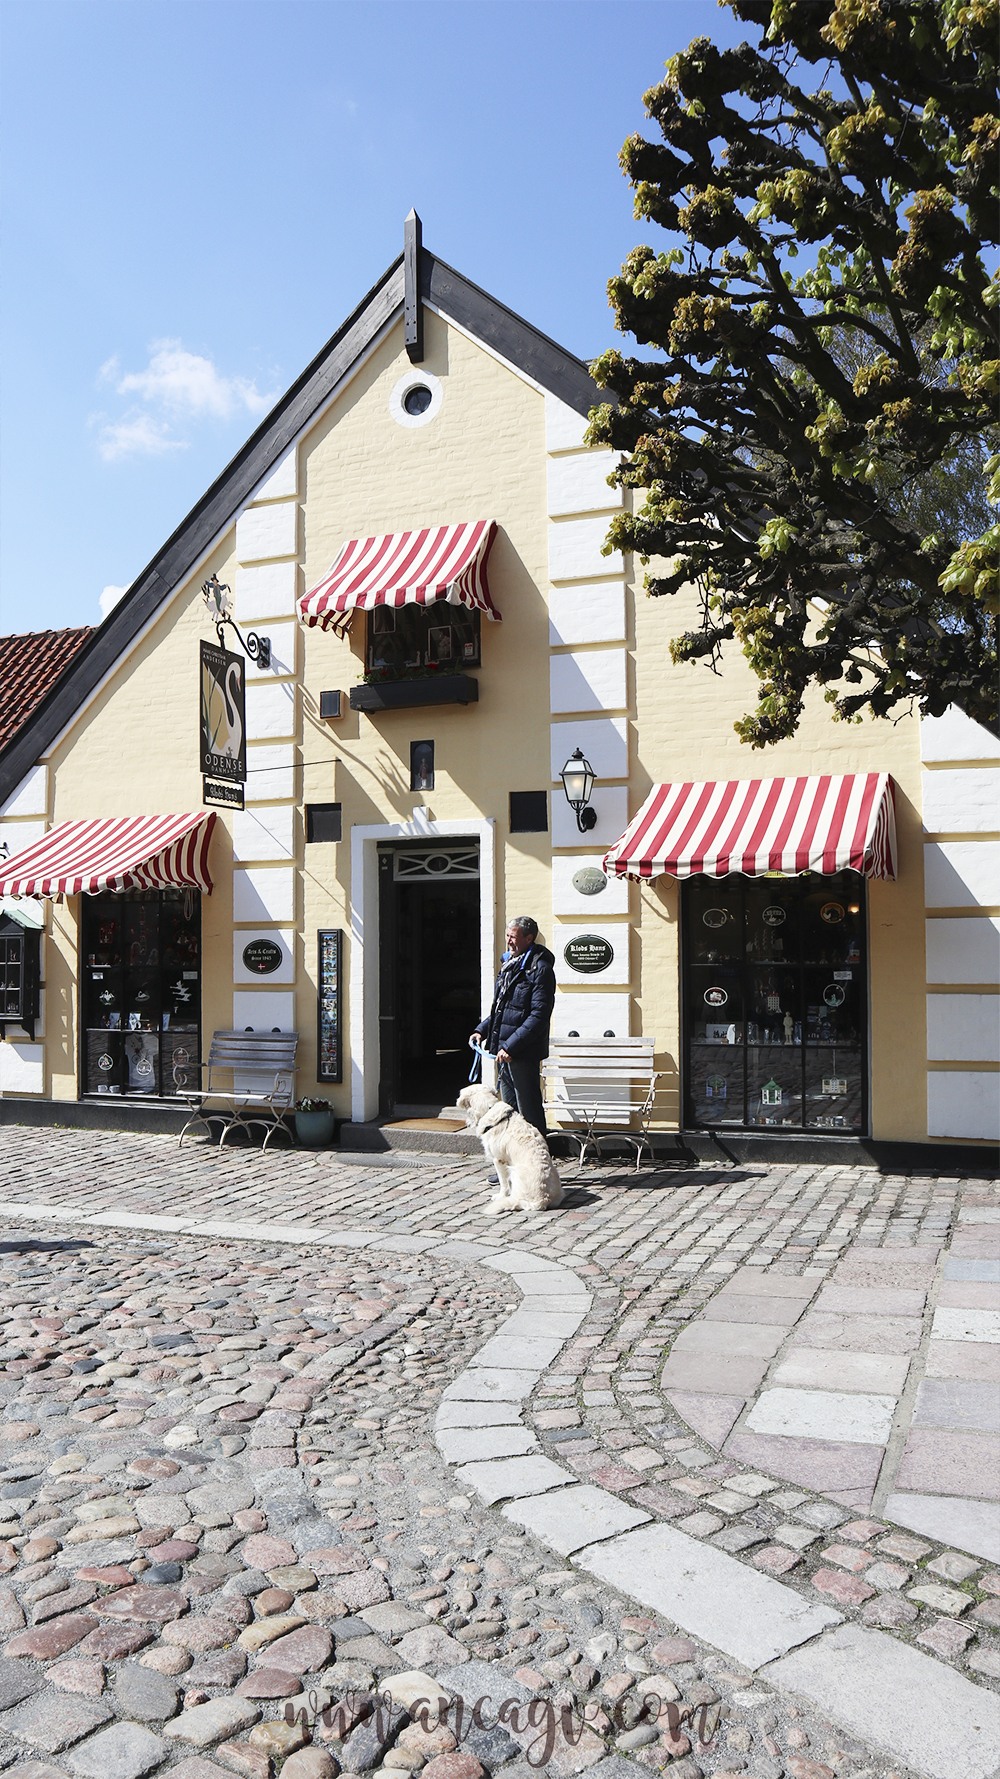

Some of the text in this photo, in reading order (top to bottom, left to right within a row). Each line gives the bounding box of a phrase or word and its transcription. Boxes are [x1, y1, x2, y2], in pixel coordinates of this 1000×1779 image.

[203, 653, 226, 666] ANDERSEN
[204, 753, 243, 772] ODENSE
[588, 944, 606, 953] Hans
